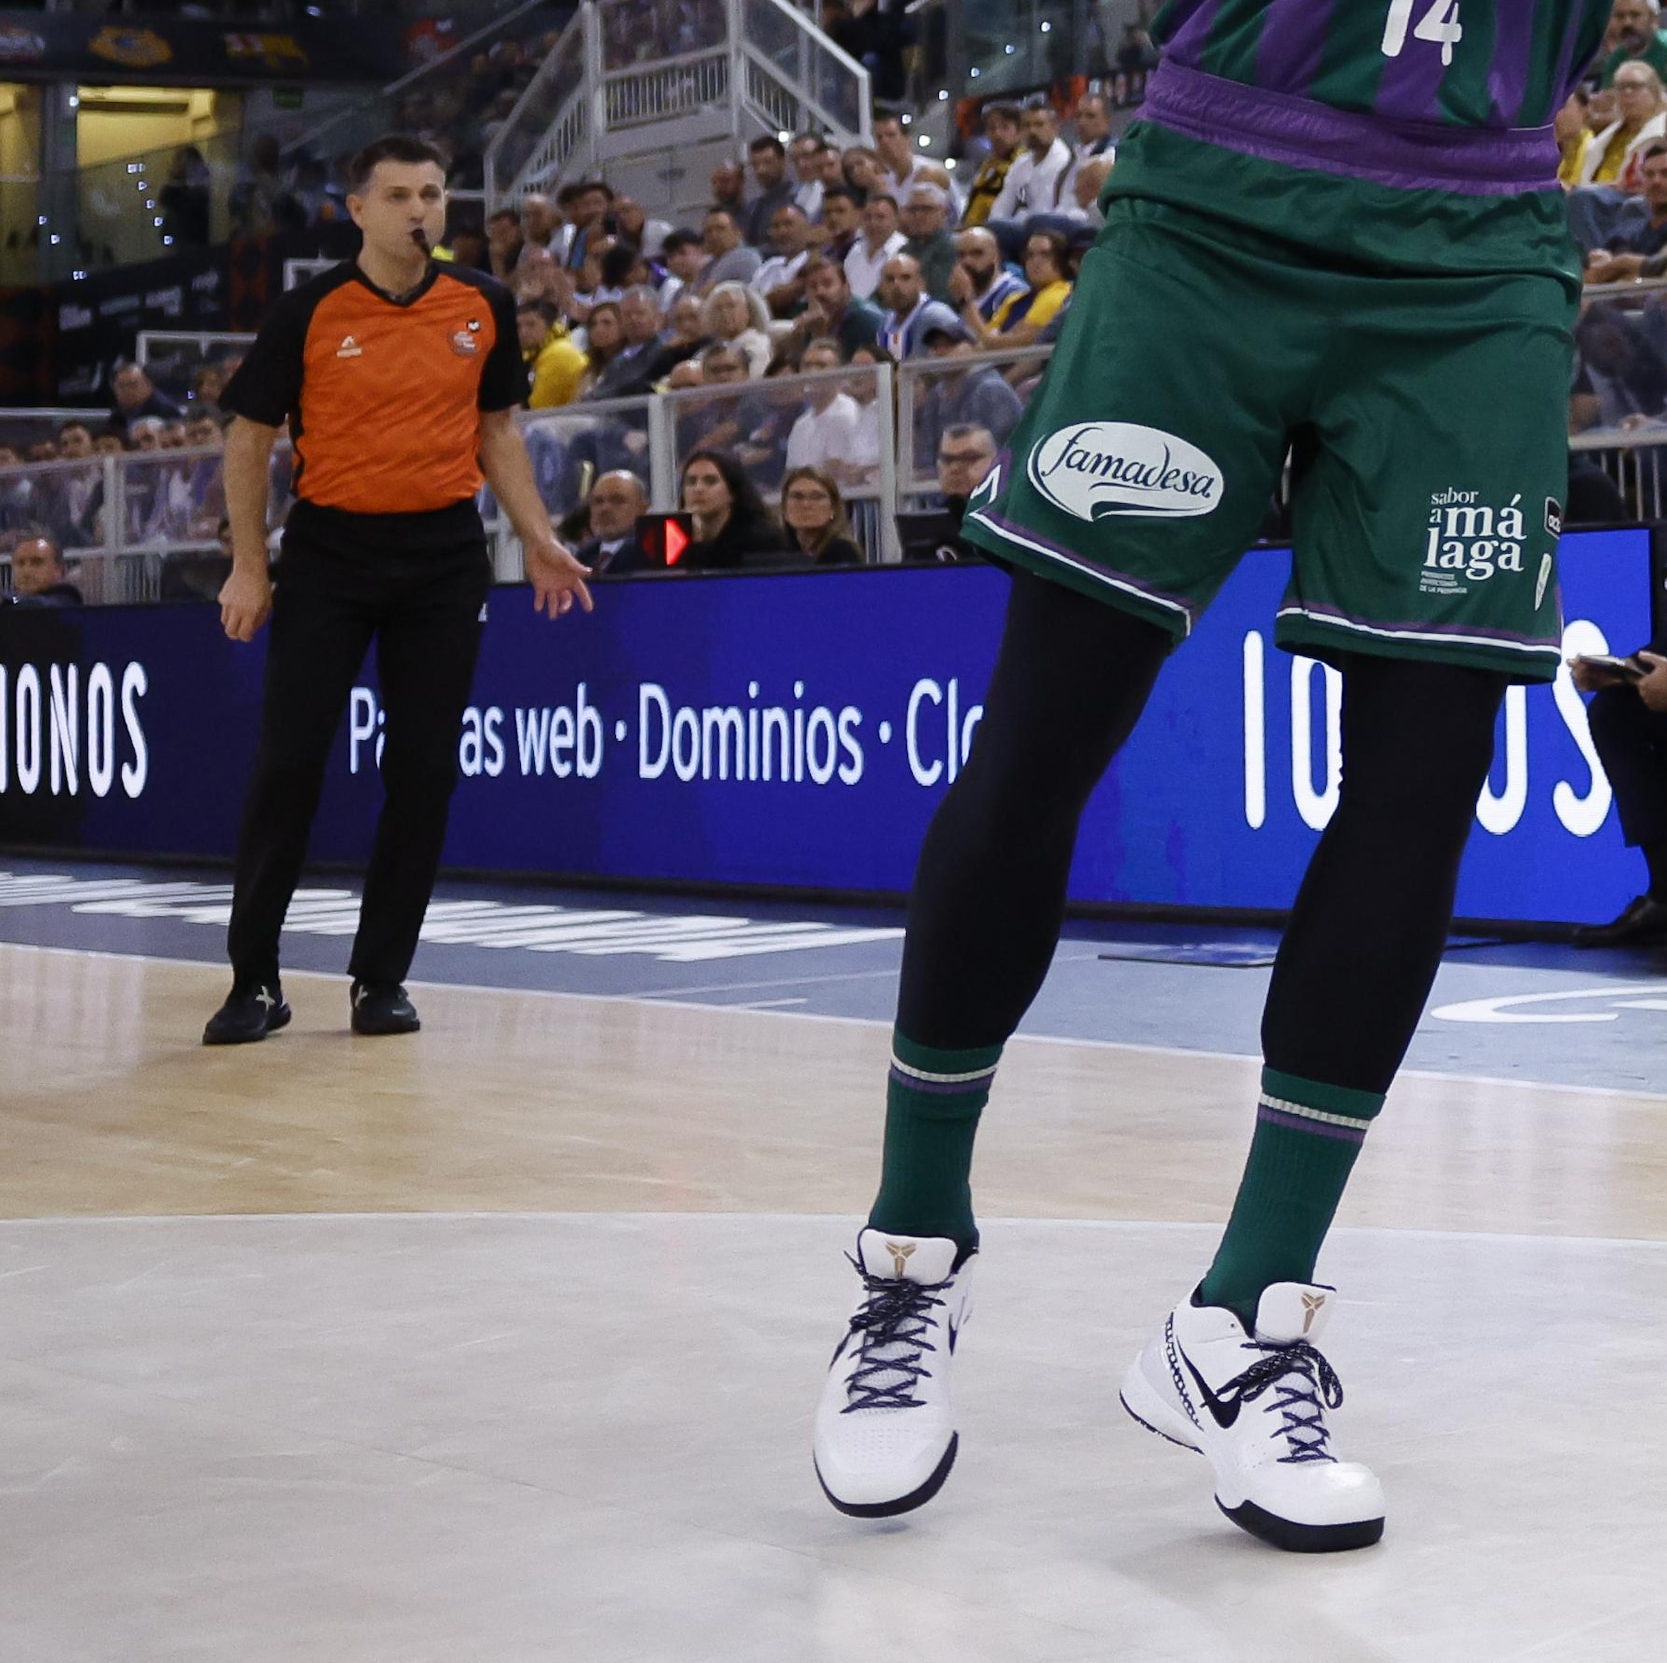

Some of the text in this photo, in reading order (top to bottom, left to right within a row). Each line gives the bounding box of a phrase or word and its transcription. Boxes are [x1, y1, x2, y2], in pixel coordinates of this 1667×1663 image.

[1041, 427, 1215, 498] famadesa
[1429, 494, 1527, 540] a má
[1431, 487, 1479, 505] sabor
[1423, 527, 1524, 580] laga
[515, 682, 602, 778] web
[638, 681, 863, 784] Dominios
